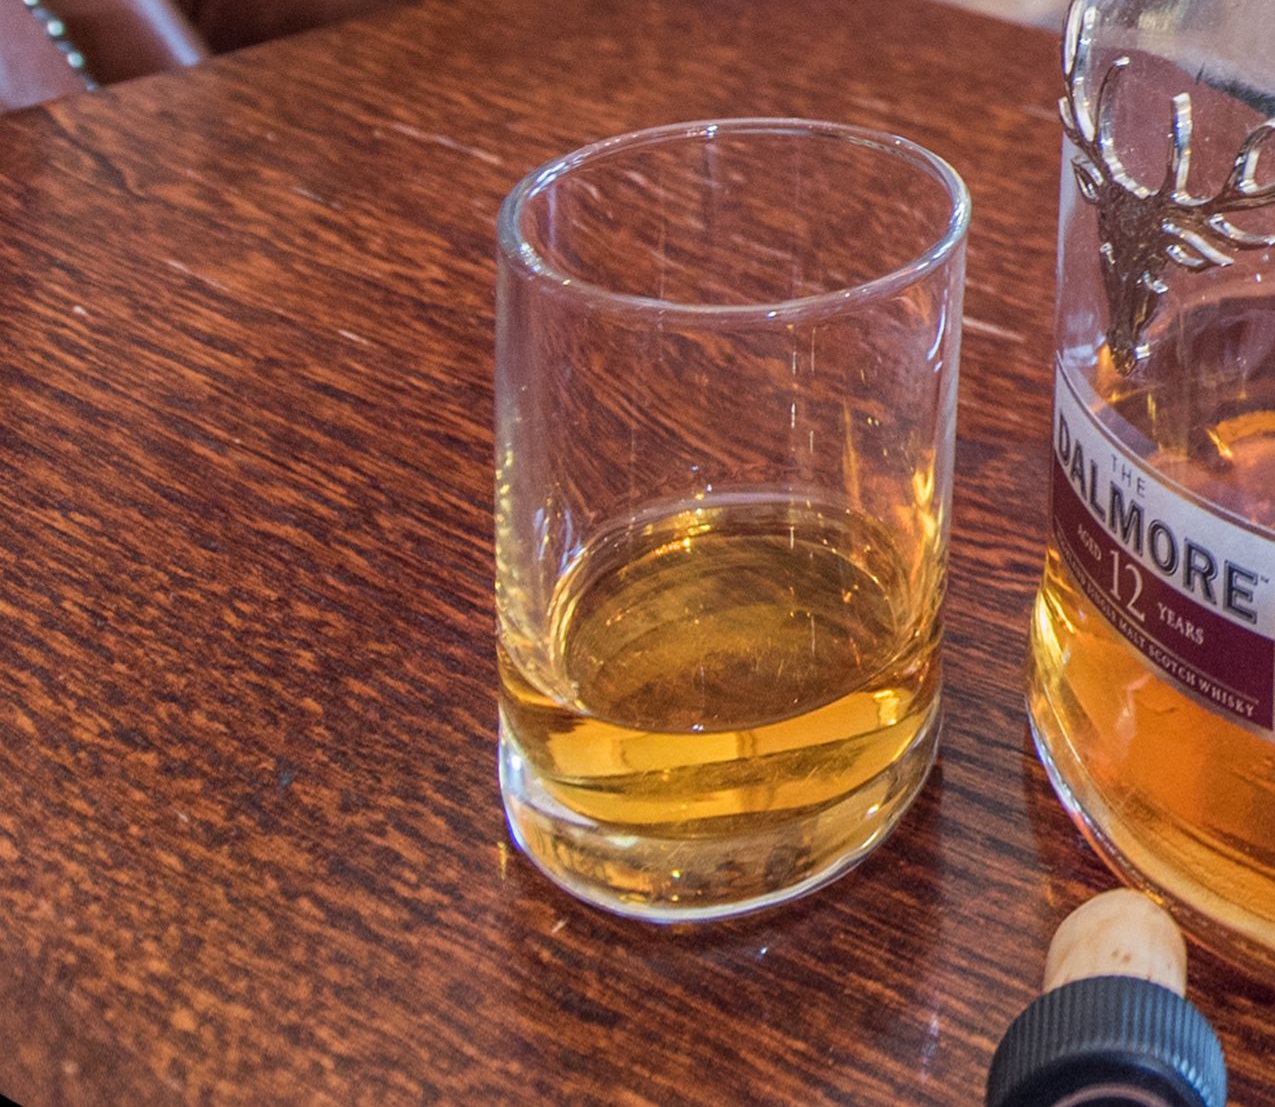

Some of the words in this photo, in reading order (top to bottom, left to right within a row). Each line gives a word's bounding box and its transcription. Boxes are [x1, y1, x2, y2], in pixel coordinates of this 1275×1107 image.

[1110, 452, 1147, 499] THE
[1108, 549, 1146, 624] 12
[1157, 600, 1205, 646] YEARS
[1118, 617, 1146, 649] MALT
[1148, 644, 1197, 685] SCOTCH
[1199, 677, 1256, 719] WHISKY
